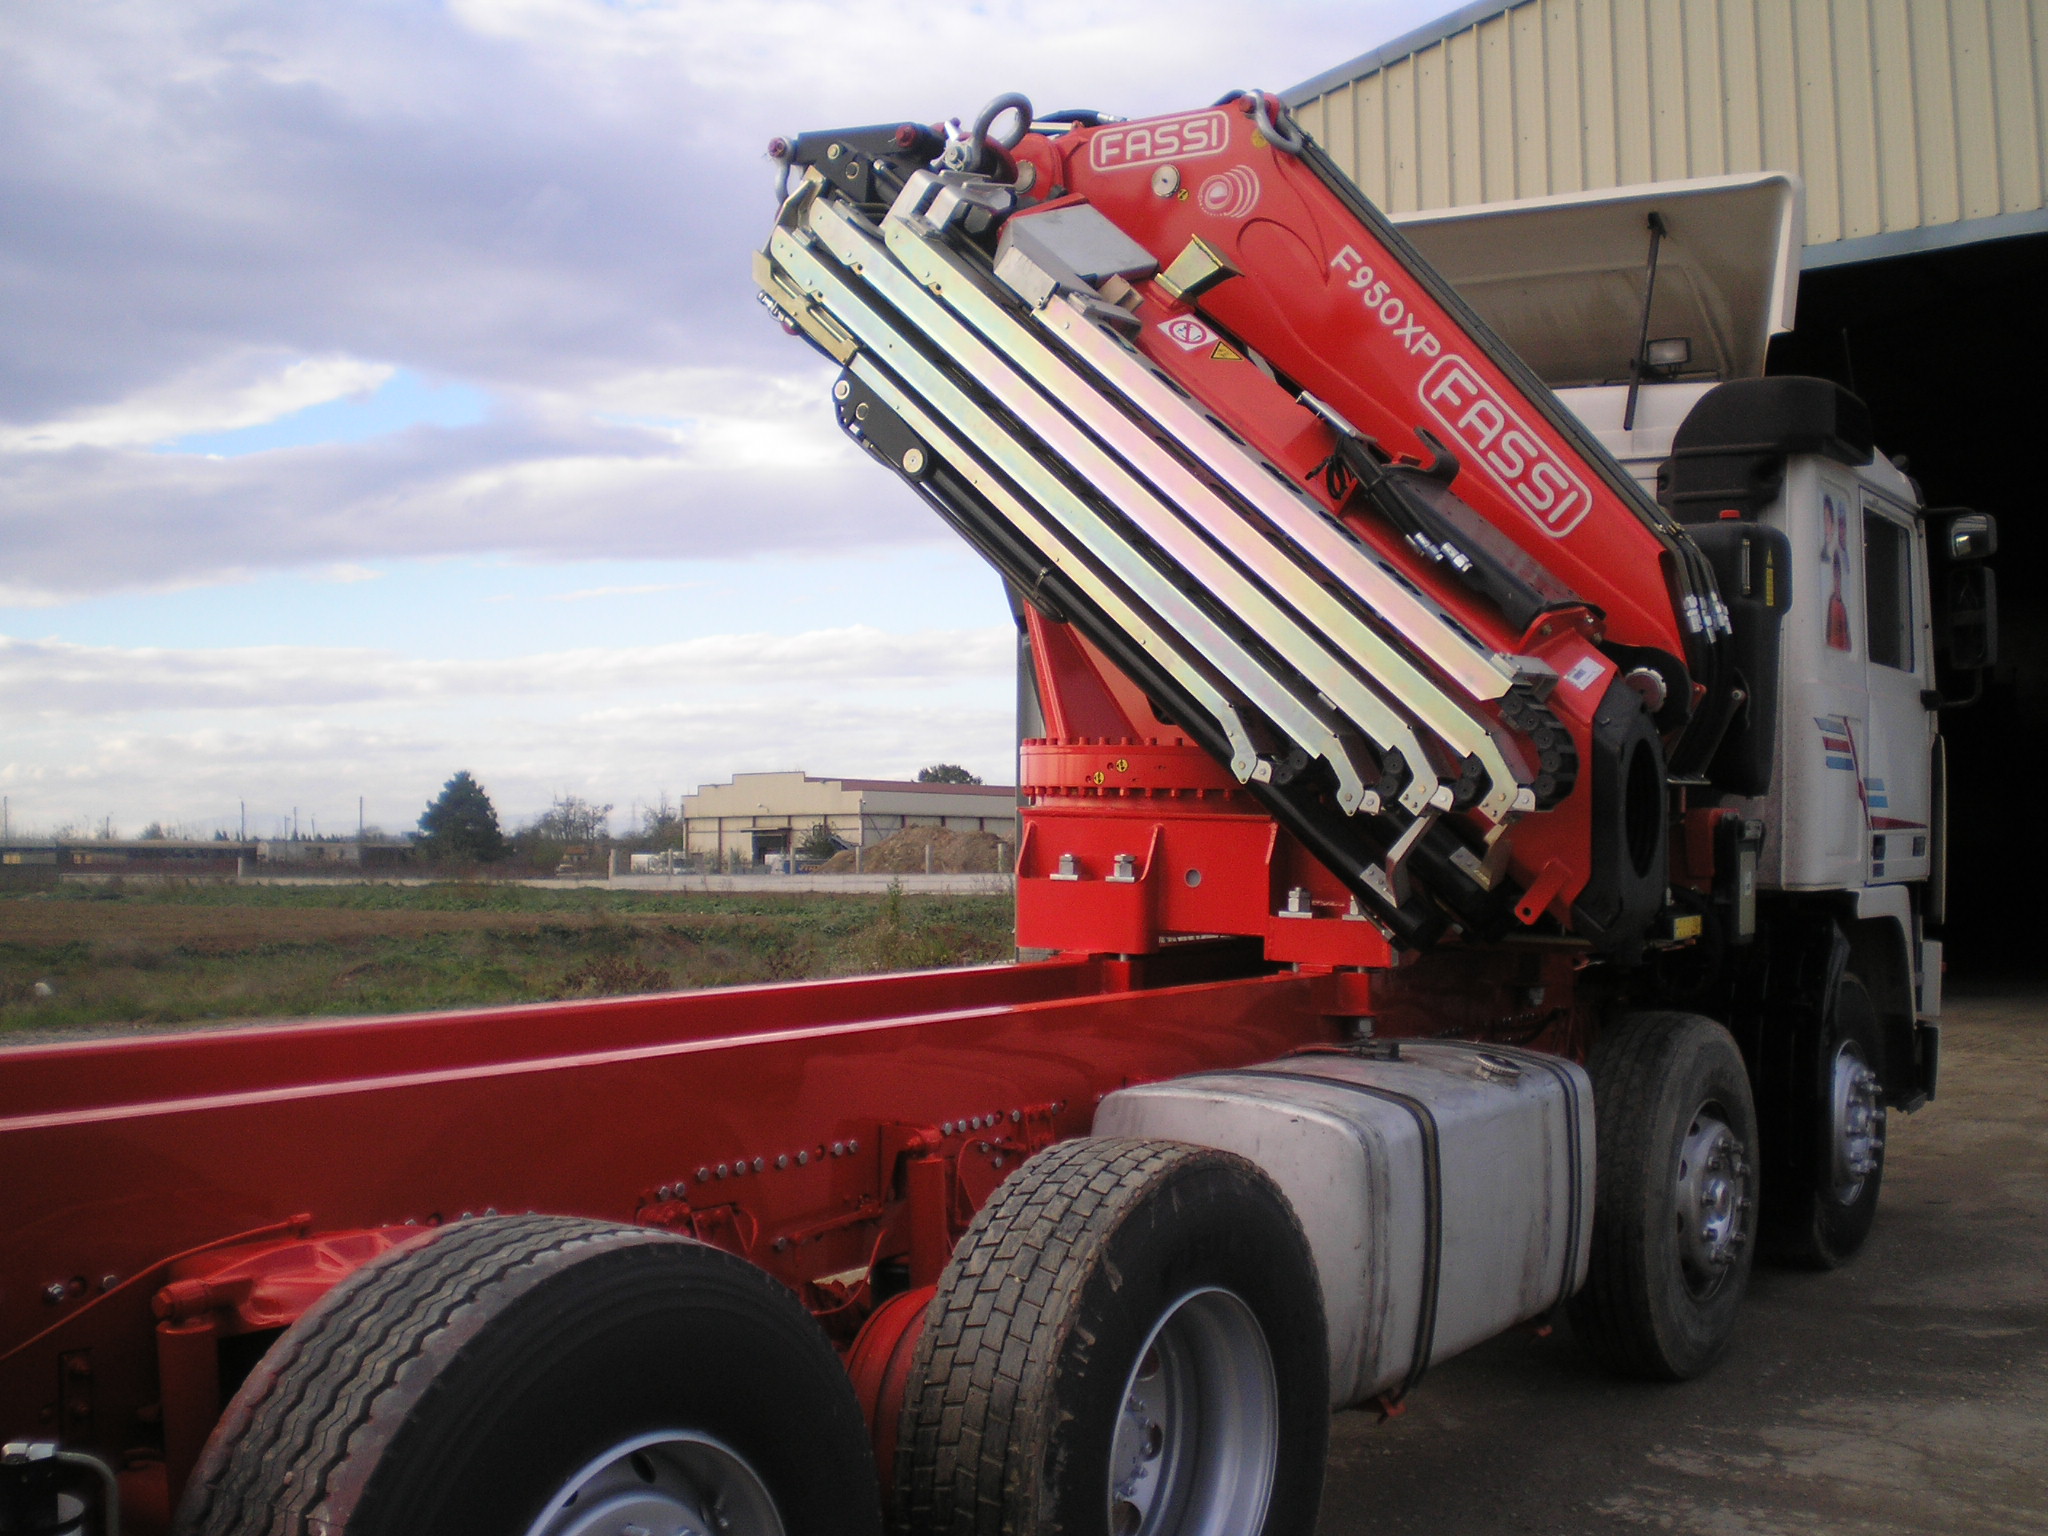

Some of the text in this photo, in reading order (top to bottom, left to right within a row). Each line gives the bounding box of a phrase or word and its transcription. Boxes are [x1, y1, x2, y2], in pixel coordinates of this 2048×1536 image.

[1100, 118, 1218, 164] FASSI
[1330, 244, 1441, 357] F950XP
[1431, 368, 1578, 523] FASSI
